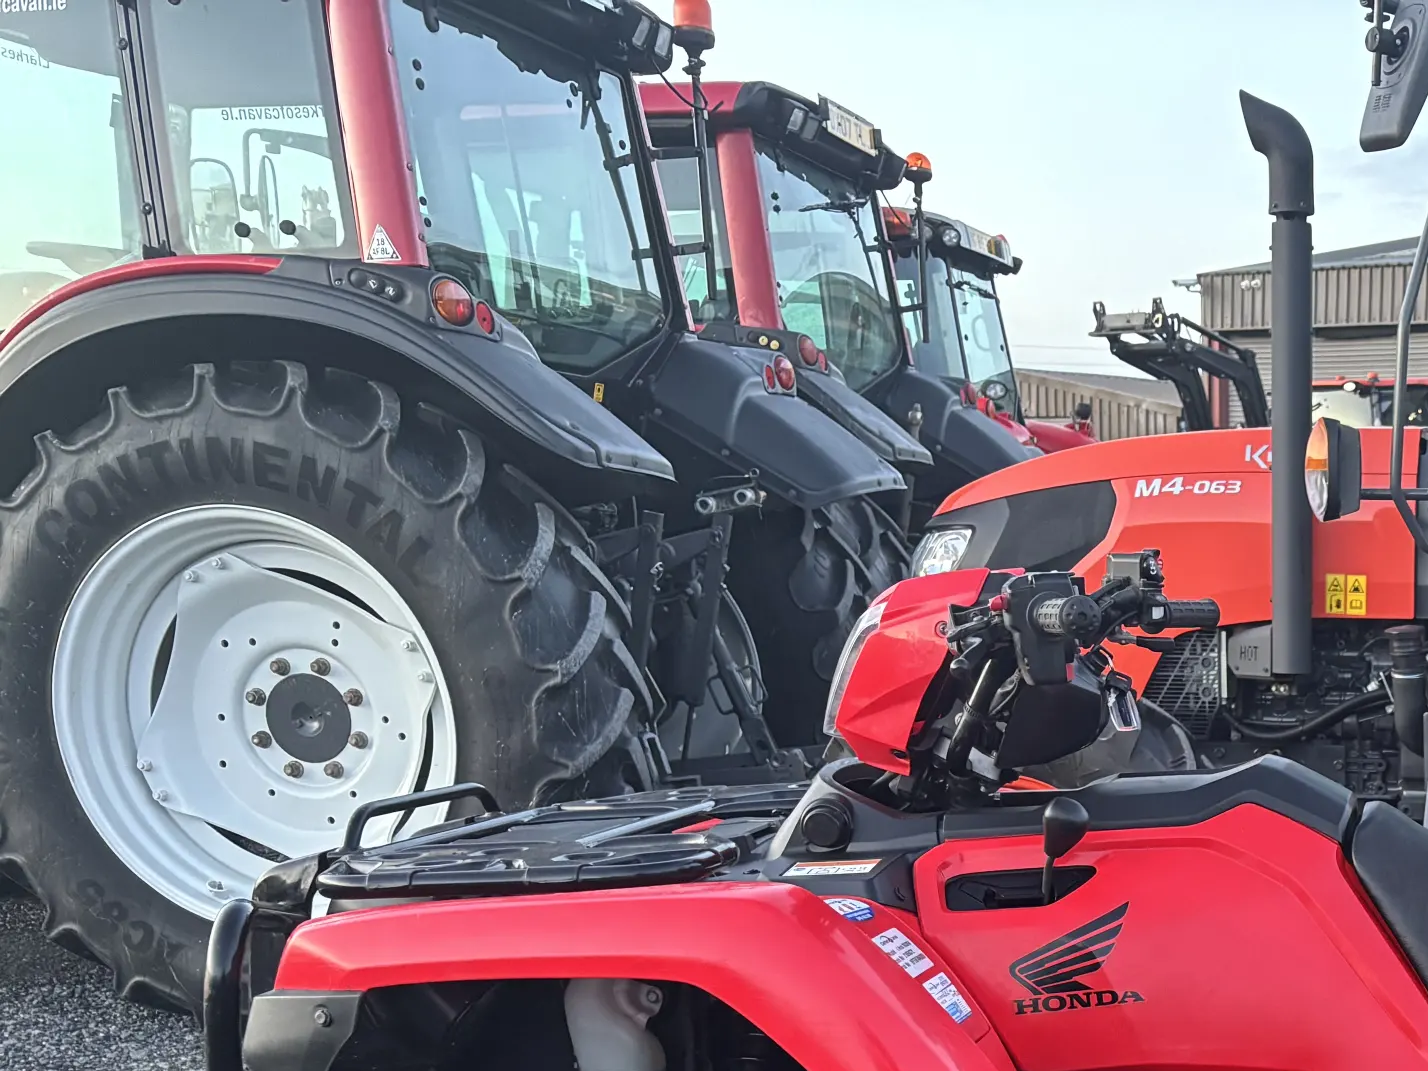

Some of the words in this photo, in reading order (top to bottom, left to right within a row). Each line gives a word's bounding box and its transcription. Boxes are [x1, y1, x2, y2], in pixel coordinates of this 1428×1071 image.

[0, 0, 67, 13] cavan.ie
[1134, 476, 1242, 498] M4-063
[36, 436, 432, 588] CONTINENTAL
[1240, 645, 1259, 661] HOT
[1014, 990, 1147, 1015] HONDA
